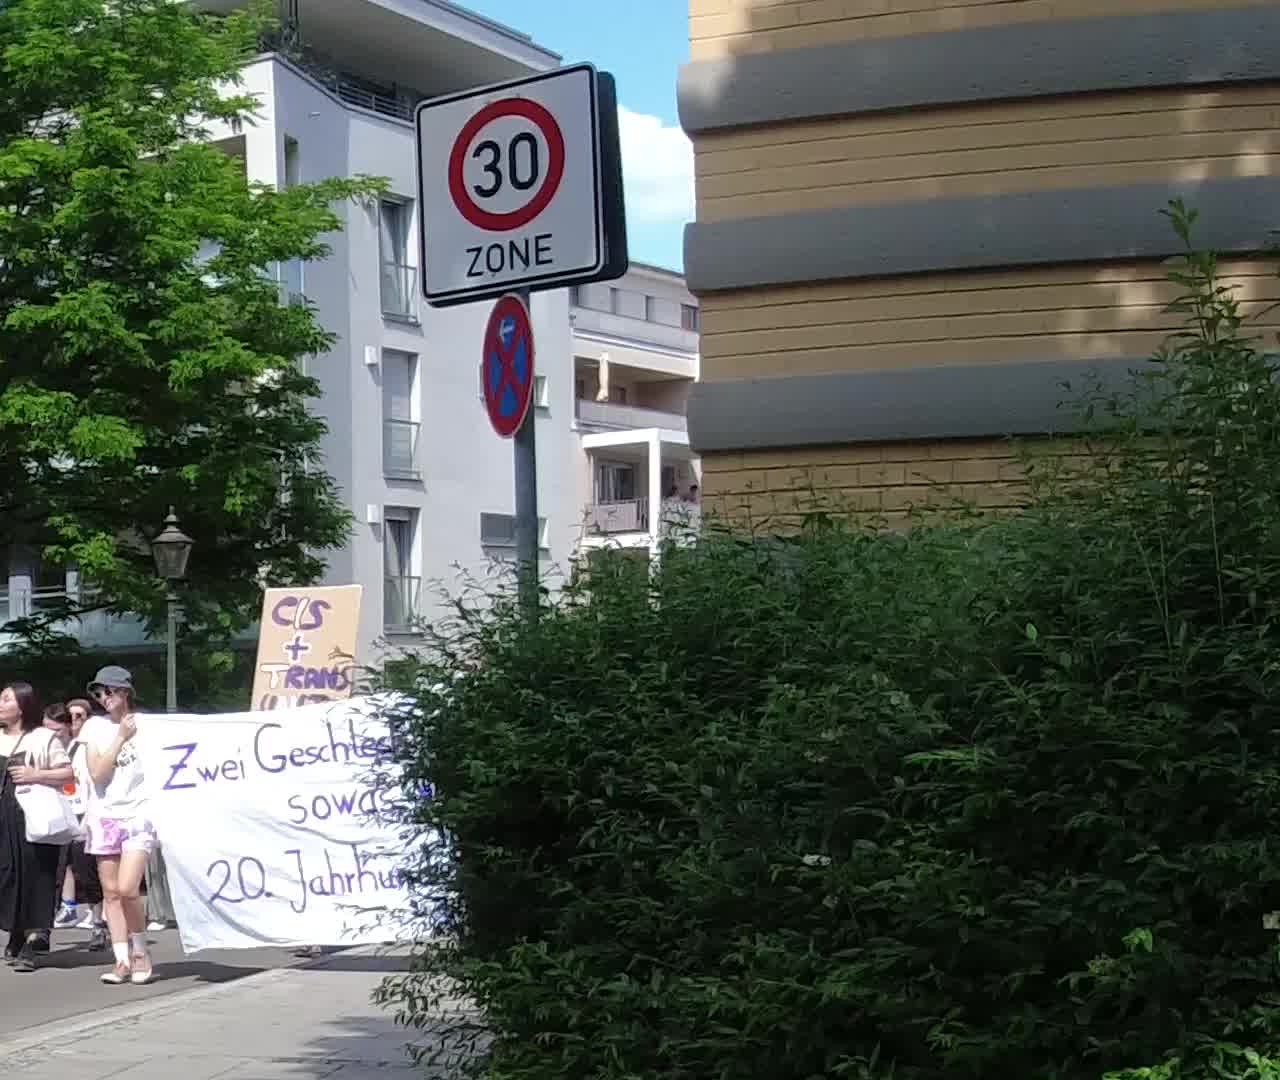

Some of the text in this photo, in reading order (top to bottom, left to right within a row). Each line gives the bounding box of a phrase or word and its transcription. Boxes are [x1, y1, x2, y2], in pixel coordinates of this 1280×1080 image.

[472, 132, 539, 198] 30
[466, 233, 553, 277] ZONE
[272, 596, 331, 630] CIS
[162, 742, 245, 790] Zwei
[206, 856, 272, 903] 20.
